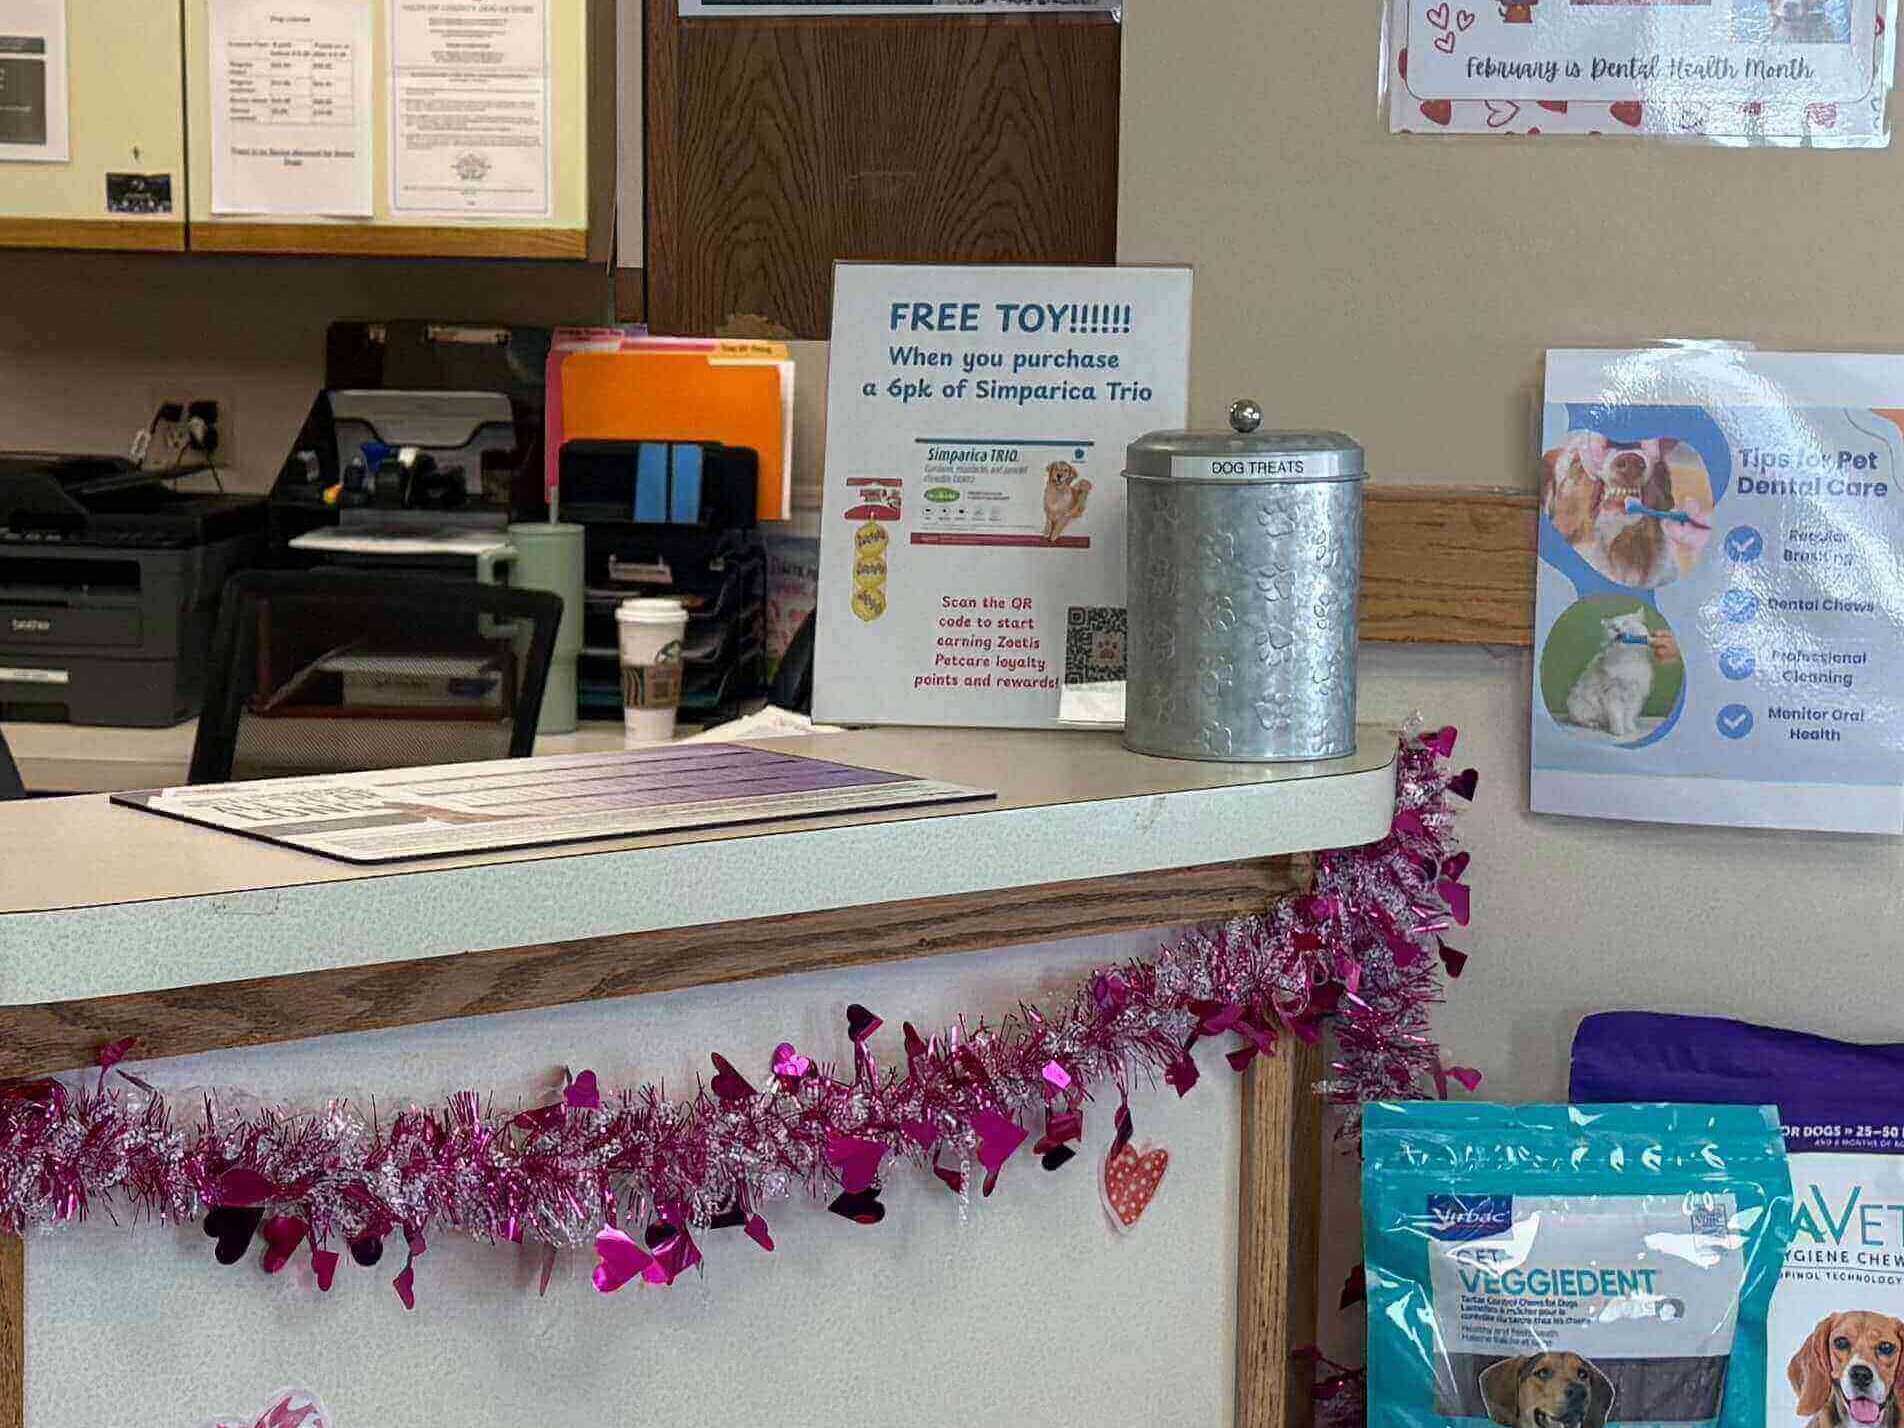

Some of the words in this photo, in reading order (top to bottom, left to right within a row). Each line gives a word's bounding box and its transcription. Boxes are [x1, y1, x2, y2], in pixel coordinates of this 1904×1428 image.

[1467, 56, 1559, 82] February
[1565, 57, 1581, 79] is
[1590, 55, 1661, 80] Dental
[1667, 55, 1738, 81] Health
[1743, 57, 1814, 81] Month
[889, 302, 980, 332] FREE
[996, 302, 1133, 335] TOY!!!!!!
[888, 347, 953, 367] When
[962, 351, 1004, 374] you
[1012, 348, 1120, 373] purchase
[862, 383, 877, 397] a
[888, 379, 933, 403] 6pk
[942, 379, 968, 400] of
[974, 379, 1097, 406] Simparica
[1107, 382, 1153, 402] Trio
[928, 448, 987, 464] Simparica
[990, 449, 1019, 462] TRIO
[1739, 448, 1790, 475] Tips
[1837, 451, 1879, 470] Pet
[1211, 460, 1246, 476] DOG
[1249, 459, 1305, 475] TREATS
[1737, 476, 1820, 496] Dental
[1827, 477, 1888, 497] Care
[942, 595, 976, 609] Scan
[981, 596, 1005, 609] the
[1011, 597, 1033, 610] QR
[1768, 597, 1819, 612] Dental
[1823, 598, 1875, 613] Chews
[938, 615, 971, 629] code
[976, 617, 993, 629] to
[998, 616, 1034, 630] start
[936, 636, 992, 652] earning
[997, 635, 1041, 649] Zoetis
[935, 654, 992, 669] Petcare
[996, 655, 1046, 673] loyalty
[914, 673, 959, 690] points
[964, 674, 992, 688] and
[1782, 670, 1853, 687] Cleaning
[1768, 707, 1829, 720] Monitor
[1832, 708, 1864, 722] Oral
[1790, 728, 1841, 742] Health
[1803, 1126, 1841, 1137] DOGS
[1433, 1207, 1506, 1224] Virbac
[1785, 1250, 1849, 1264] YGIENE
[1459, 1269, 1659, 1296] VEGGIEDENT
[1827, 1272, 1902, 1285] TECHNOLOGY
